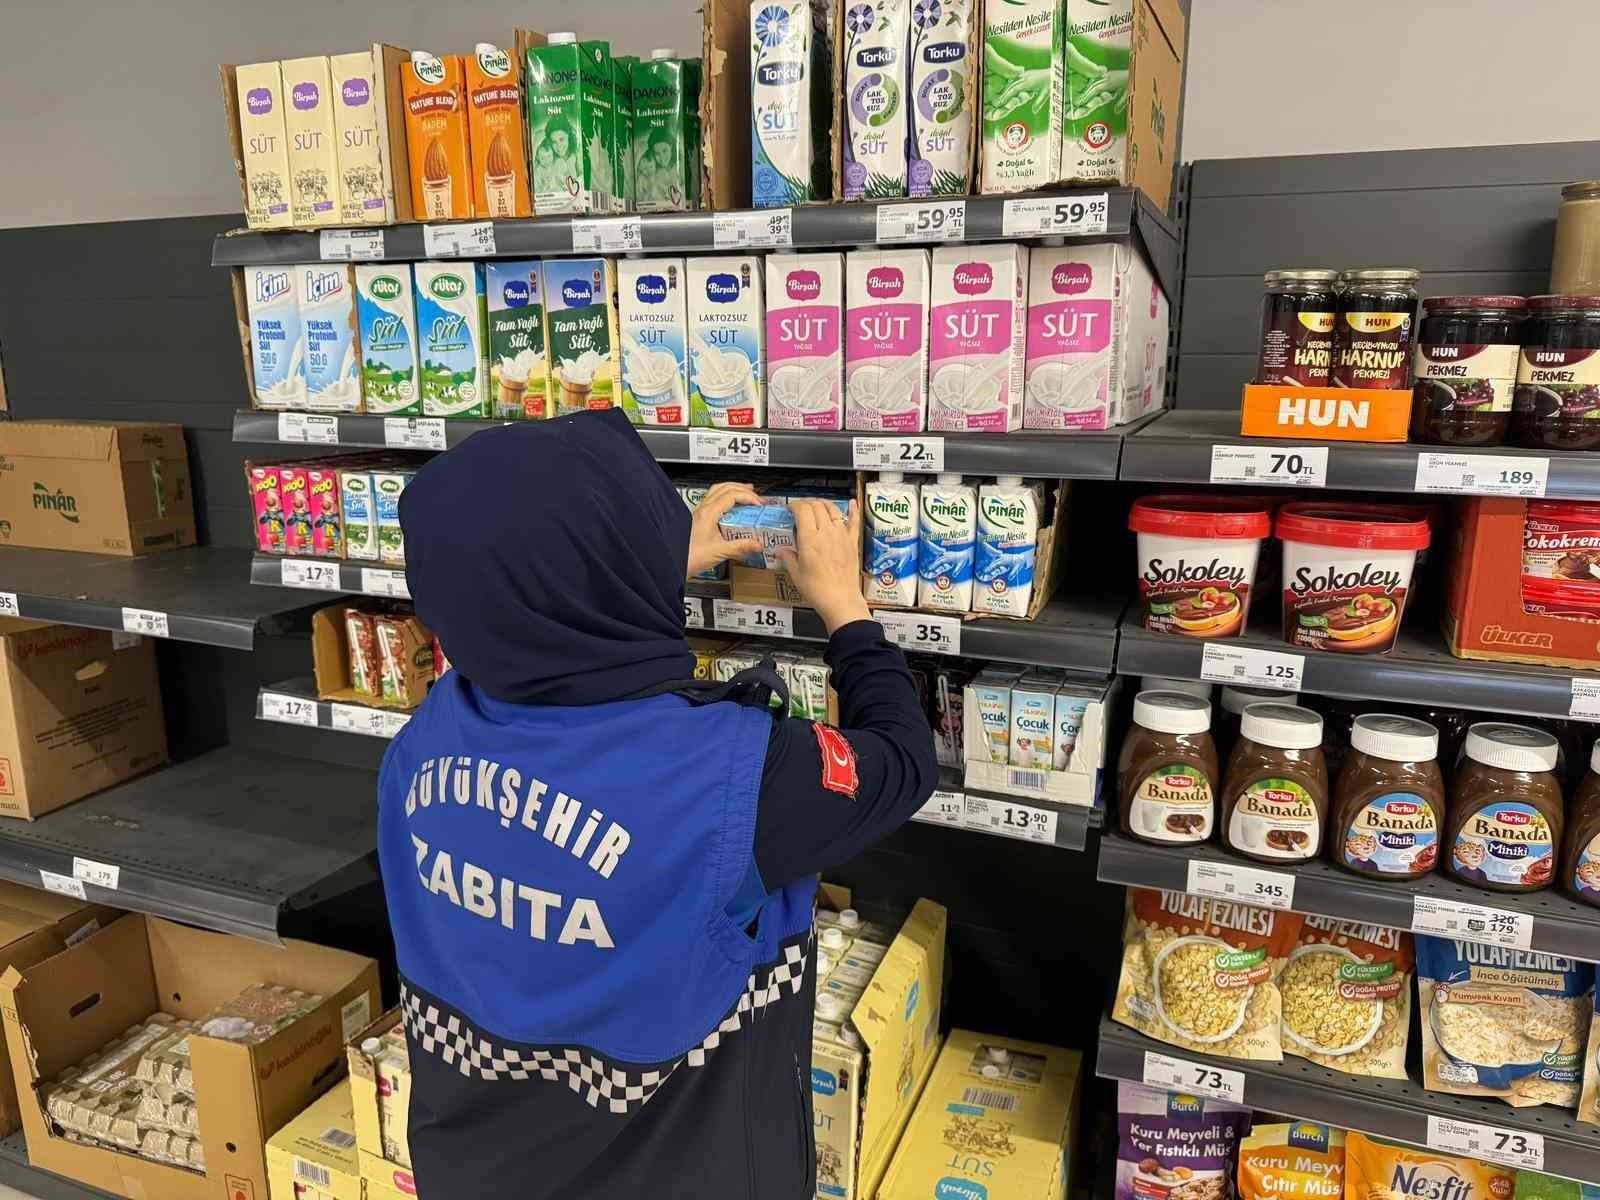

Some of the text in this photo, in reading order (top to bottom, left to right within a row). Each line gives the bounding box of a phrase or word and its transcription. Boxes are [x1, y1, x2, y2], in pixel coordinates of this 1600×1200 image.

[861, 50, 893, 64] Torku
[928, 46, 961, 60] Torku
[763, 67, 801, 81] Torku
[250, 133, 276, 154] SÜT
[294, 128, 321, 151] SÜT
[344, 125, 373, 149] SÜT
[1054, 202, 1106, 224] 59,95
[1094, 213, 1105, 222] TL
[708, 280, 738, 295] Birşah
[787, 278, 819, 293] Birşah
[867, 275, 905, 292] Birşah
[955, 271, 994, 288] Birşah
[1053, 271, 1092, 288] Birşah
[637, 281, 666, 297] Birşah
[554, 314, 604, 334] Tam Yağlı
[629, 312, 675, 323] LAKTOZSUZ
[699, 312, 748, 323] LAKTOZSUZ
[944, 309, 1000, 340] SÜT
[1042, 307, 1099, 339] SÜT
[1365, 318, 1392, 327] HUN
[495, 320, 517, 333] Tam
[780, 313, 829, 343] SÜT
[858, 311, 912, 342] SÜT
[508, 334, 531, 349] Süt
[568, 334, 593, 350] Süt
[639, 326, 666, 345] SÜT
[710, 326, 740, 345] SÜT
[1341, 348, 1406, 369] HARNUP
[1431, 347, 1459, 358] HUN
[1535, 352, 1566, 364] HUN
[1426, 364, 1468, 378] PEKMEZ
[1530, 370, 1576, 383] PEKMEZ
[1277, 397, 1370, 429] HUN
[728, 437, 768, 455] 45,50
[758, 447, 768, 456] TL
[899, 443, 926, 461] 22
[925, 452, 935, 461] TL
[1270, 454, 1315, 475] 70 TL
[1499, 470, 1534, 486] 189
[1144, 558, 1247, 588] Şokoley
[1290, 562, 1402, 596] Şokoley
[754, 609, 777, 626] 18
[777, 619, 785, 628] TL
[915, 624, 943, 642] 35
[942, 634, 952, 644] TL
[1480, 624, 1554, 649] ÜLKER
[1265, 665, 1295, 679] 125
[980, 711, 1007, 724] ocuk
[1016, 716, 1051, 732] Çocuk
[1168, 777, 1193, 787] Torku
[1148, 783, 1209, 802] Banada
[1267, 791, 1294, 802] Torku
[1247, 797, 1313, 817] Banada
[1387, 804, 1416, 814] Torku
[405, 756, 632, 880] BÜYÜKŞEHİR
[1003, 808, 1048, 828] 13,90
[1366, 811, 1434, 830] Banada
[1499, 813, 1528, 824] Torku
[1475, 819, 1549, 841] Banada
[1379, 833, 1416, 846] Miniki
[1489, 841, 1529, 857] Miniki
[411, 831, 616, 949] ZABITA
[1254, 883, 1284, 897] 345
[1160, 889, 1210, 921] YULAF
[1490, 913, 1516, 925] 320
[1491, 923, 1514, 934] 179
[1493, 994, 1521, 1004] Kıvam
[1194, 1067, 1233, 1093] 73 TL
[1130, 1123, 1235, 1145] Kuru Meyveli &
[1131, 1137, 1201, 1158] Yer Fıstıklı
[1493, 1131, 1541, 1158] 73 TL
[1247, 1154, 1289, 1170] Kuru
[1261, 1174, 1298, 1194] Çıtır
[1391, 1163, 1476, 1200] Nesfit
